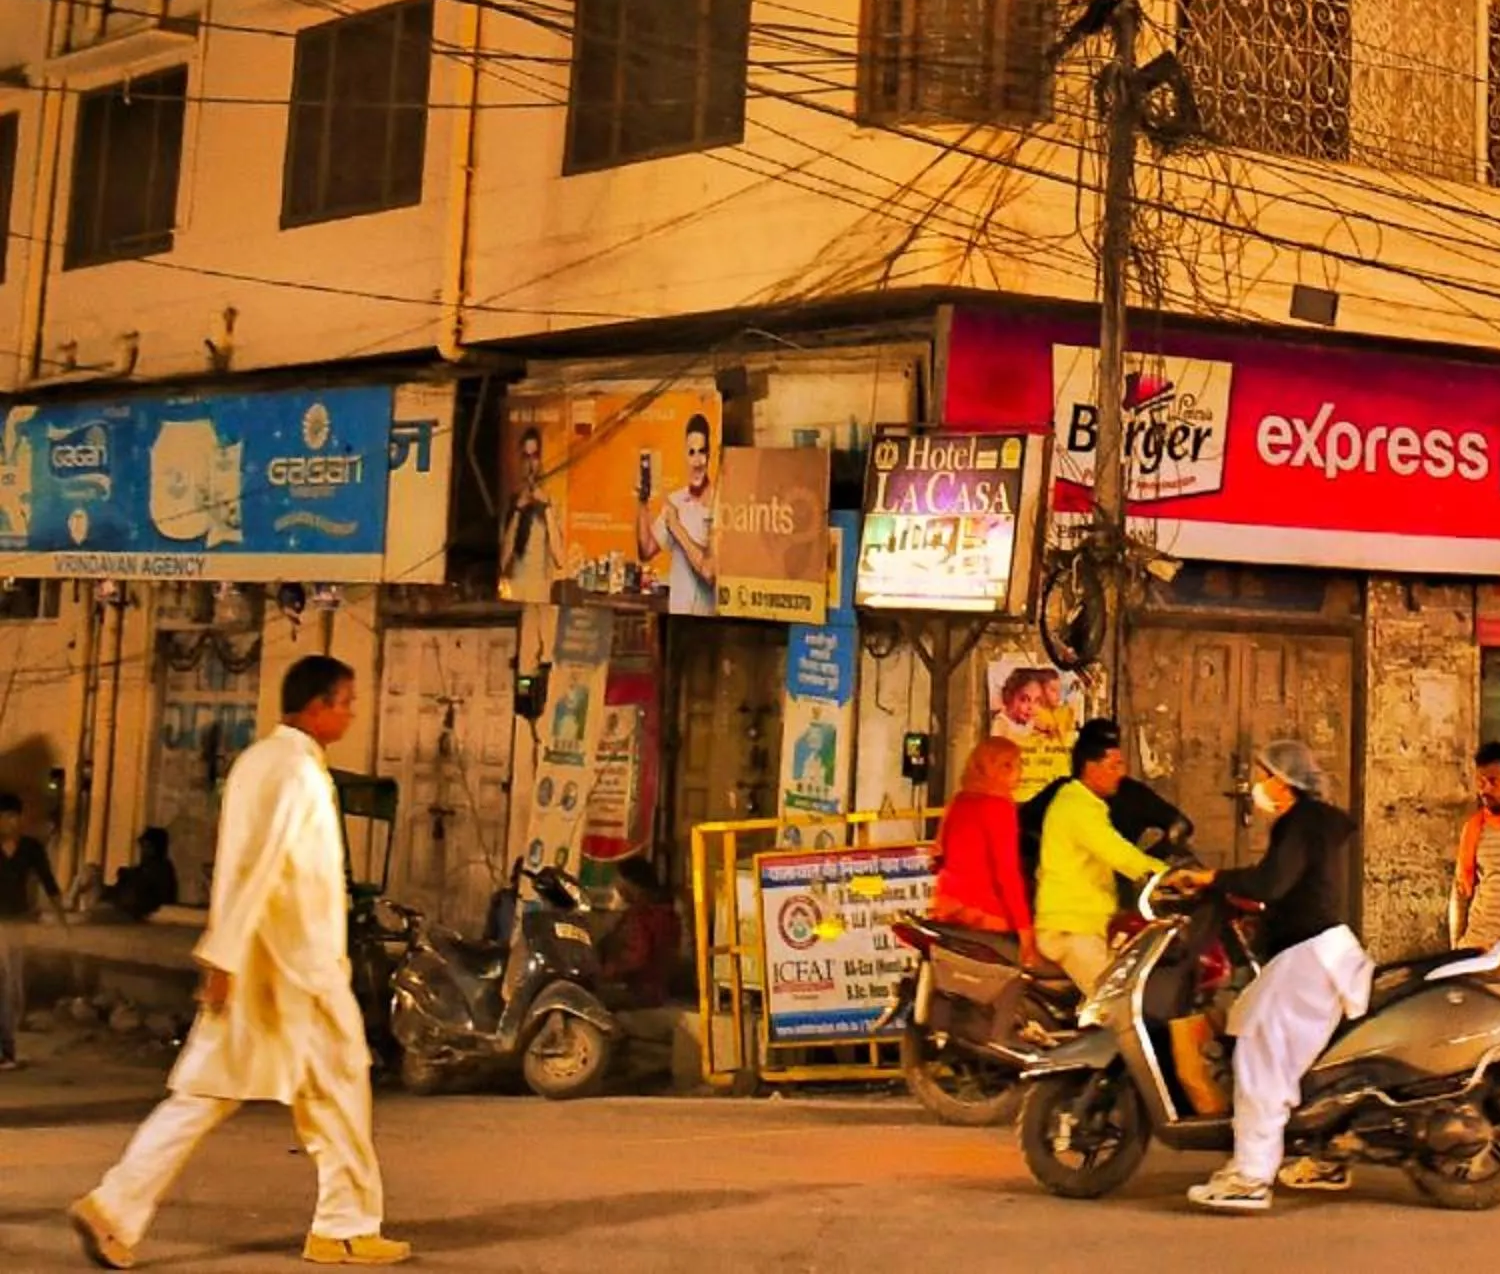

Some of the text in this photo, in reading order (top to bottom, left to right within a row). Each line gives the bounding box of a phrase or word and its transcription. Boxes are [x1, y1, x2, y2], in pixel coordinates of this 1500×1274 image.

[906, 437, 976, 471] Hotel
[1067, 402, 1212, 474] Brger
[1257, 403, 1489, 479] express
[141, 553, 206, 575] AGENCY
[773, 958, 833, 983] ICFAI
